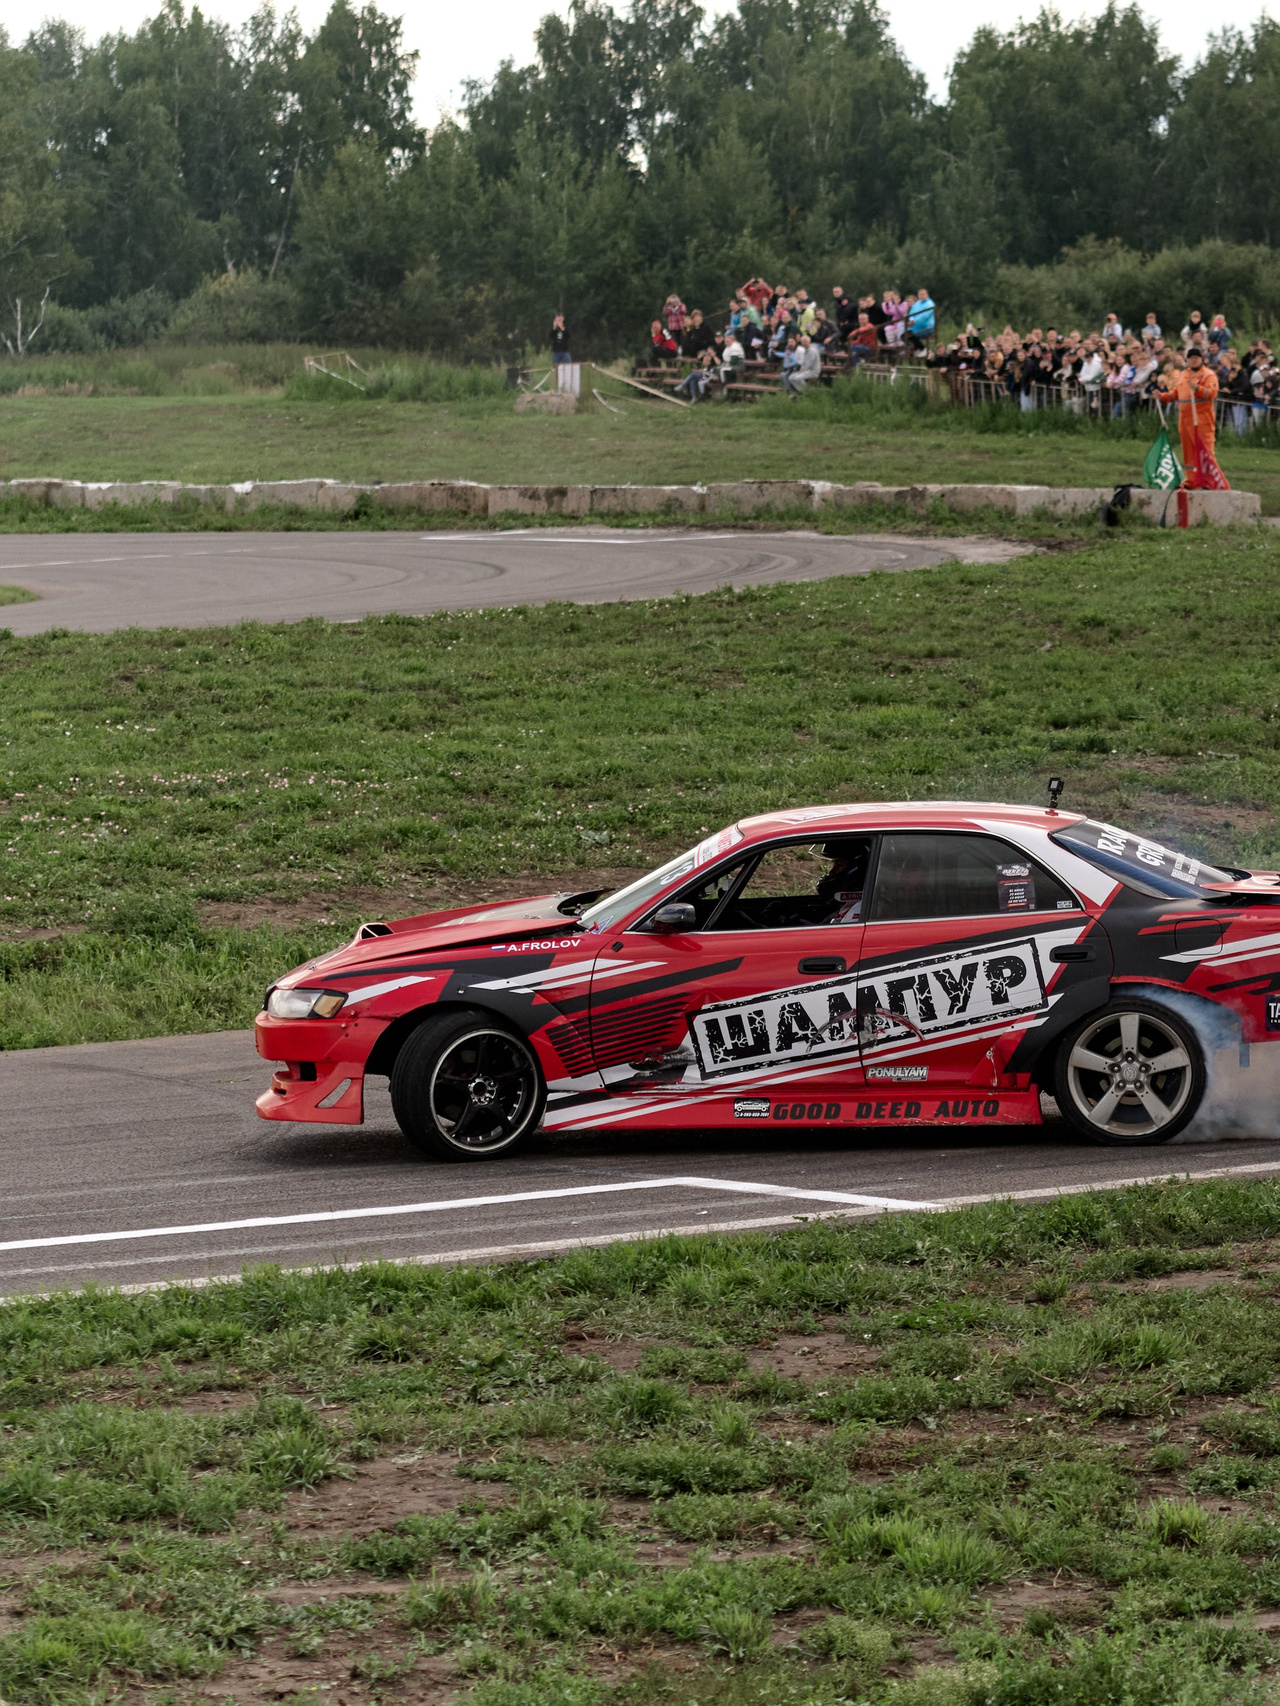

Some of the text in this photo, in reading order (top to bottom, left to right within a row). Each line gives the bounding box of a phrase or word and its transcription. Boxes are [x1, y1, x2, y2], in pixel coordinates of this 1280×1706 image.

[507, 939, 581, 953] A.FROLOV
[703, 955, 1027, 1065] ШАМПУР
[867, 1066, 928, 1078] PONULYAM
[772, 1100, 1000, 1120] GOOD DEED AUTO
